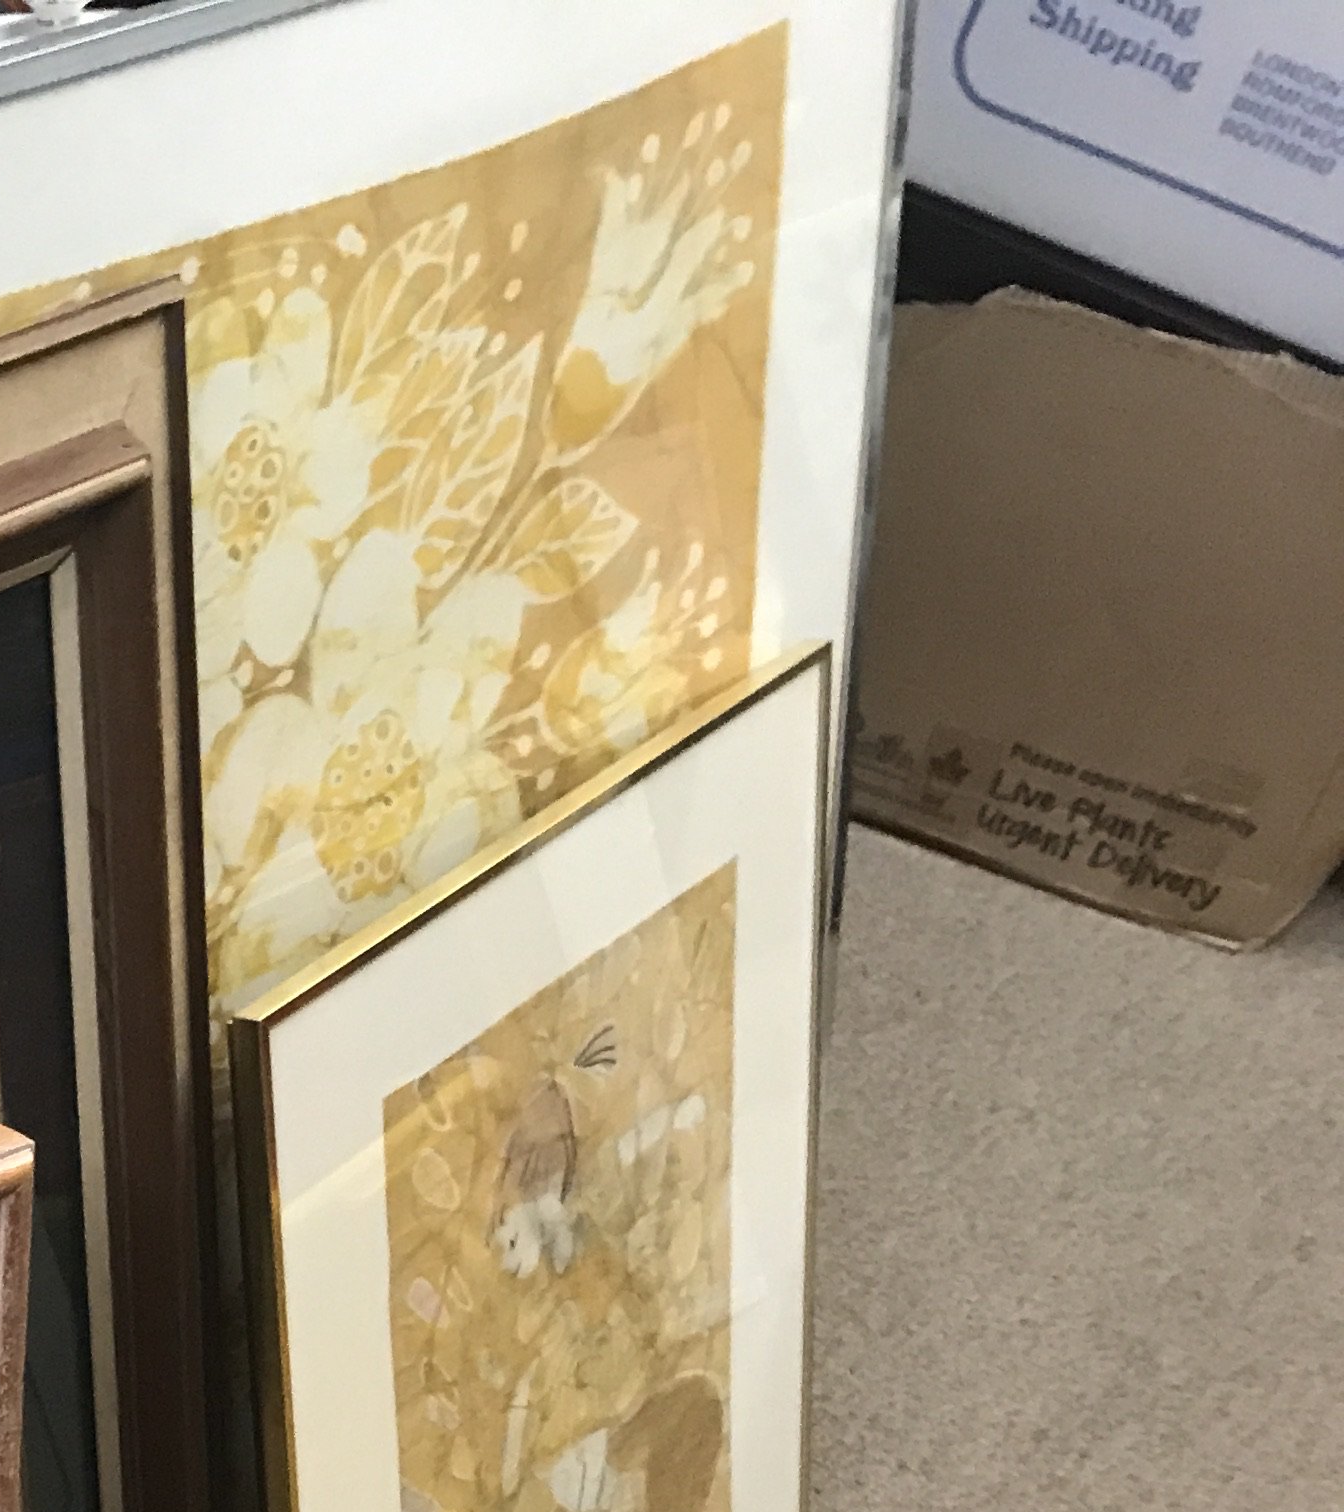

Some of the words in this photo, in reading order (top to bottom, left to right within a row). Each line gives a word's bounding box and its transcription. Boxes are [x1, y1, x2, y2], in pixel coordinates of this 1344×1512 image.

[1028, 0, 1203, 93] Shipping
[988, 768, 1056, 812] Live
[976, 802, 1083, 862] Urgent
[1086, 840, 1222, 912] Delivery
